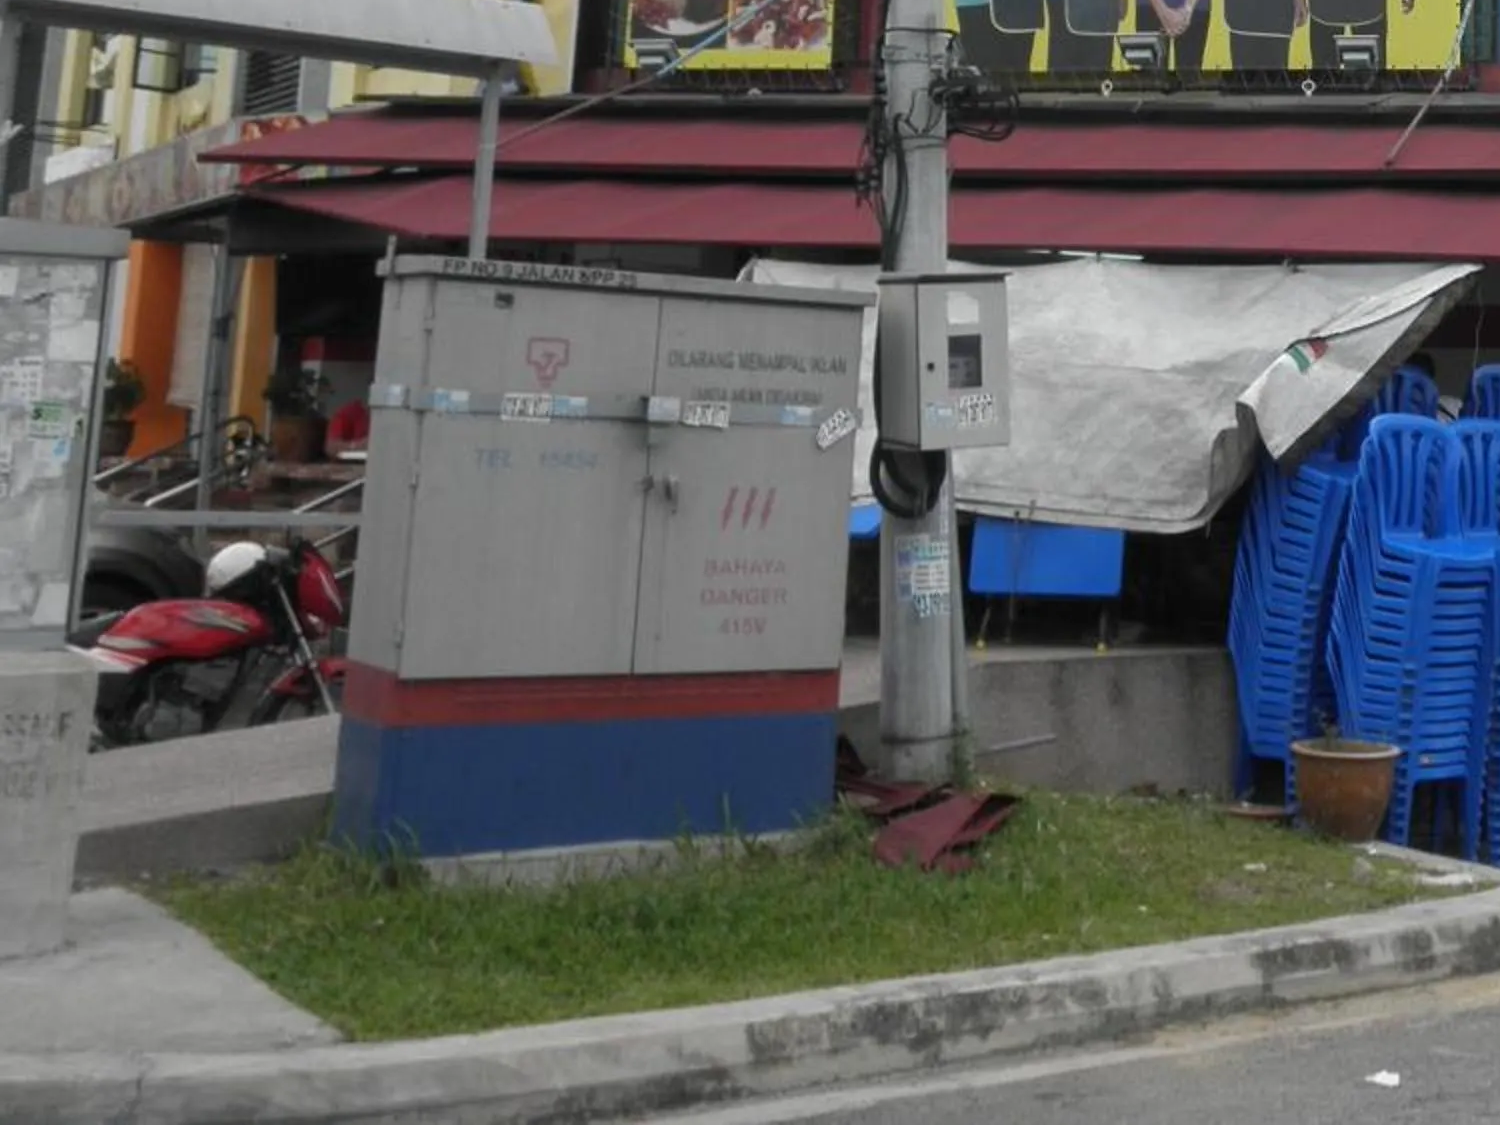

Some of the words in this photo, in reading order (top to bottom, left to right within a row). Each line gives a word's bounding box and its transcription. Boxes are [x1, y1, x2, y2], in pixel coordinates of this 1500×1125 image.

[516, 263, 575, 283] JALAN
[703, 558, 786, 575] BAHAYA
[700, 588, 788, 605] DANGER
